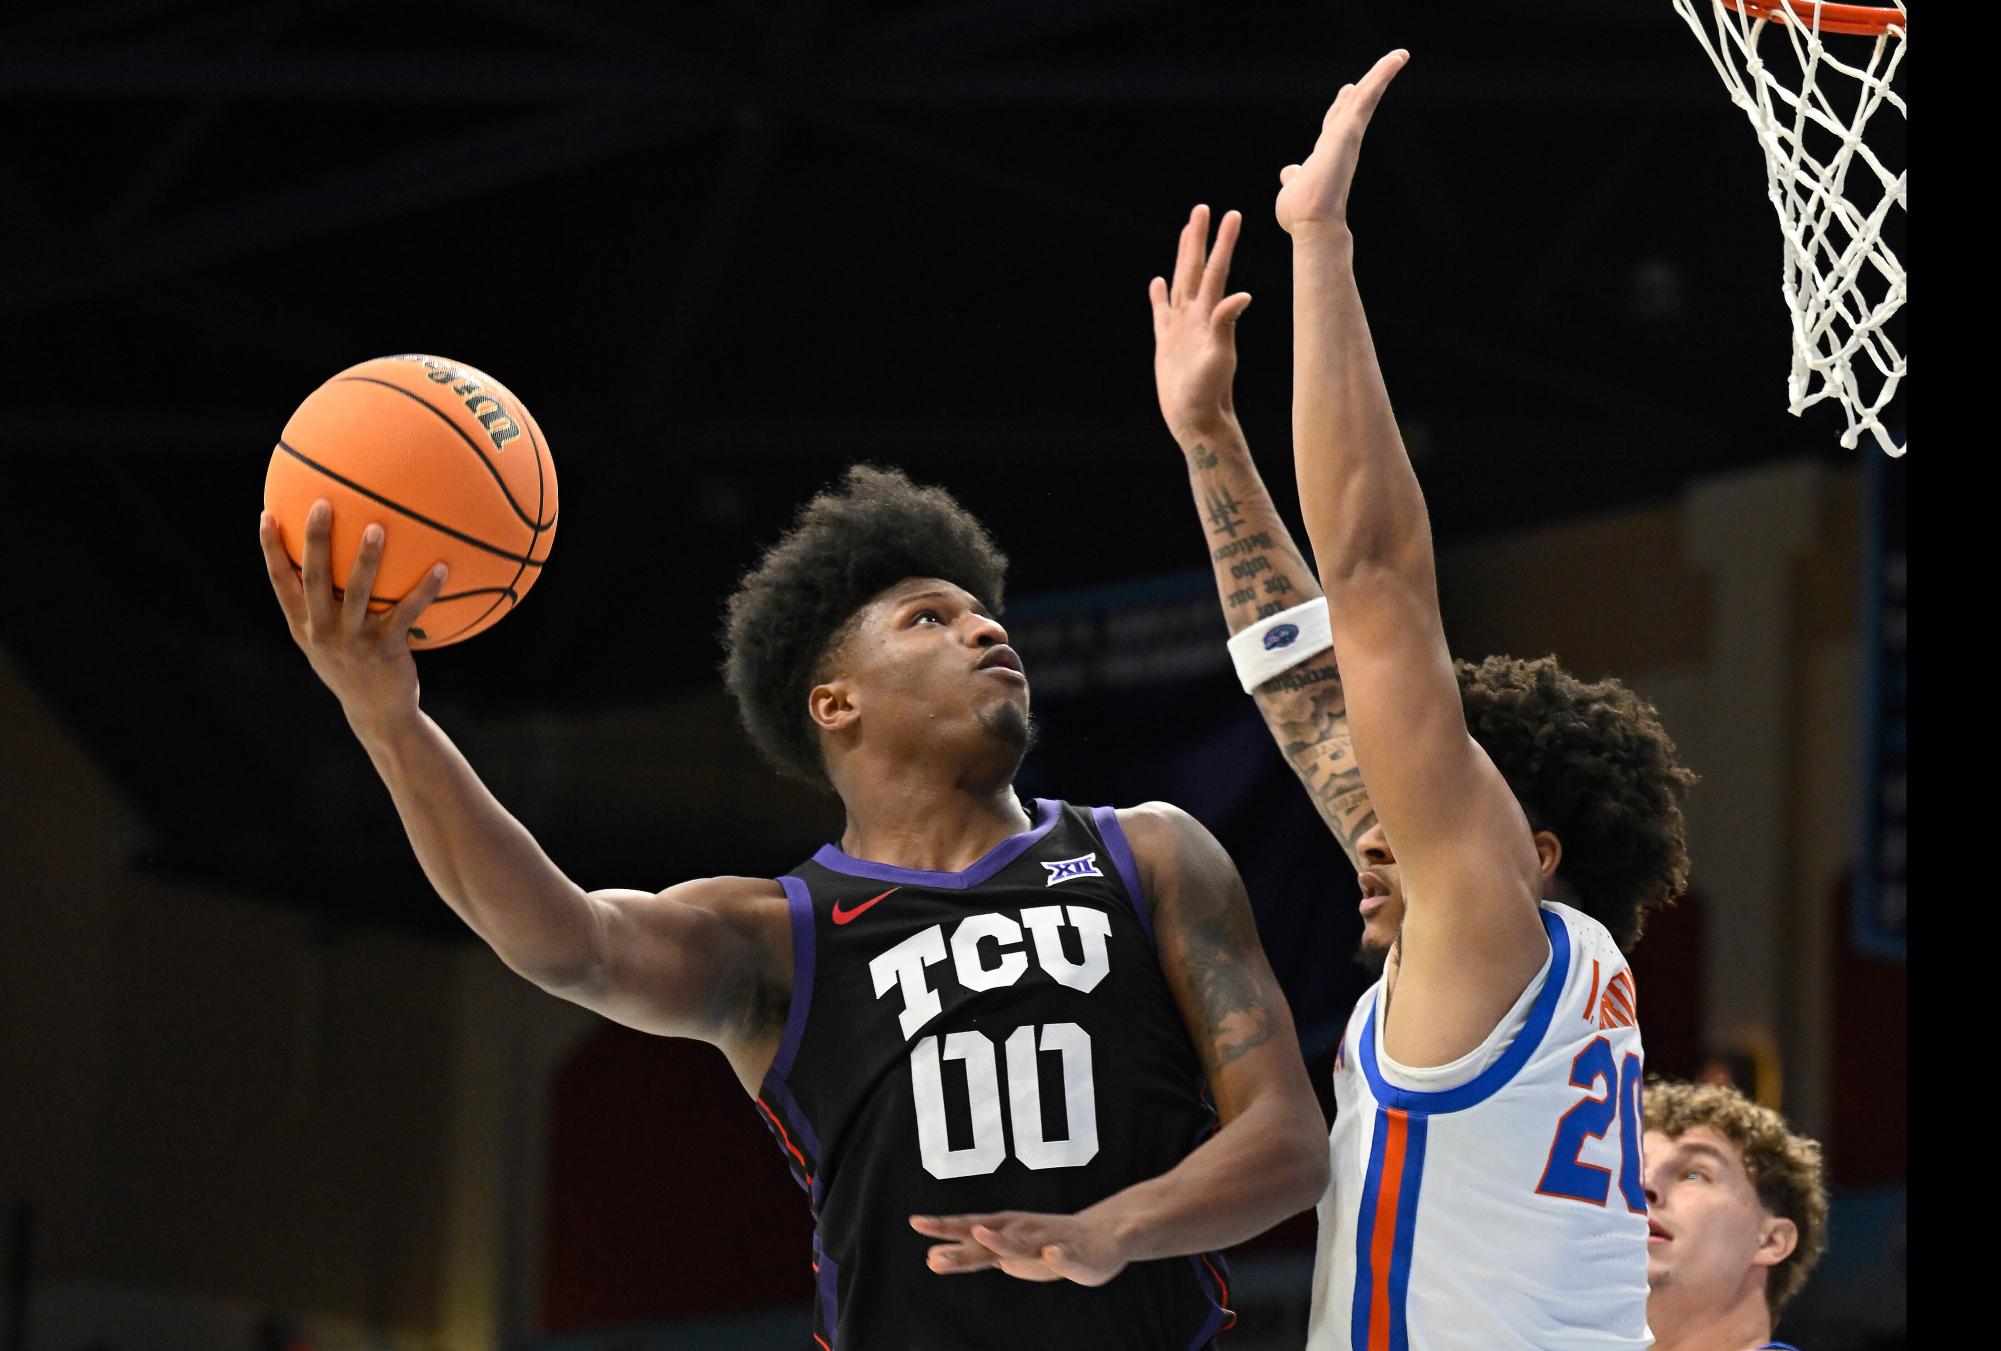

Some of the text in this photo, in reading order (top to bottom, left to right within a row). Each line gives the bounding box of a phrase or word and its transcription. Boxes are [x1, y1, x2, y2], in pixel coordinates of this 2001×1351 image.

[1045, 856, 1099, 882] XII
[868, 904, 1113, 1042] TCU
[909, 1022, 1100, 1180] 00
[1534, 1035, 1648, 1216] 20
